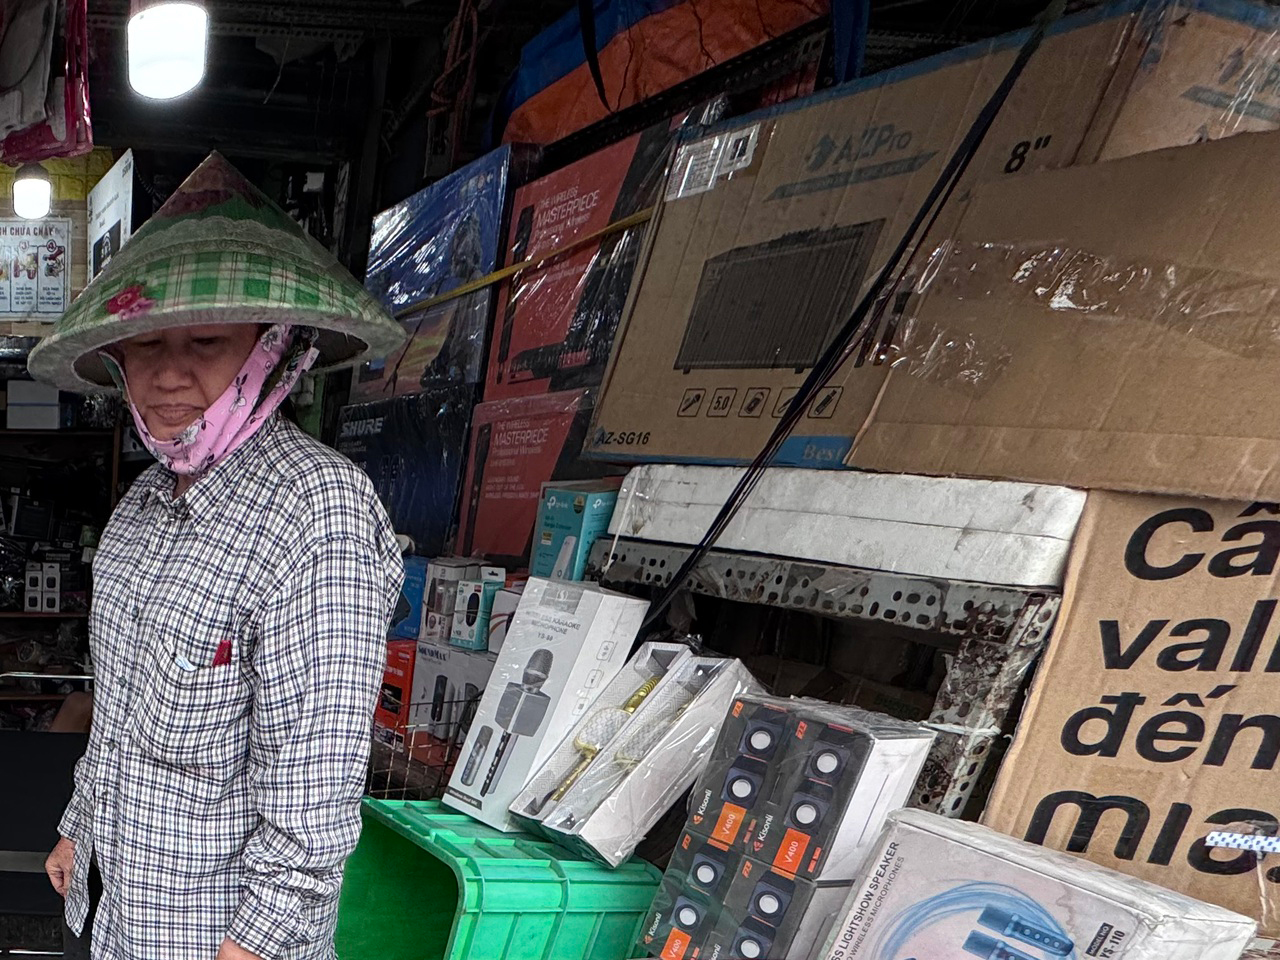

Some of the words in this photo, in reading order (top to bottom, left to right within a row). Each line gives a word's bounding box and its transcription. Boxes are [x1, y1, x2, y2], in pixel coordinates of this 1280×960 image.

[537, 190, 600, 226] MASTERPIECE
[341, 416, 385, 437] SHURE
[494, 428, 549, 446] MASTERPIECE
[596, 430, 651, 446] AZ-SG16
[697, 789, 712, 816] Kisonli
[723, 813, 735, 835] V400
[758, 814, 773, 842] Kisonli
[786, 840, 799, 864] V400
[840, 893, 873, 951] LIGHTSHOW
[867, 841, 900, 897] SPEAKER
[852, 916, 873, 958] WIRELESS
[869, 856, 905, 917] MICROPHONES
[650, 913, 662, 937] Kisonli
[669, 938, 681, 959] V400
[1100, 930, 1126, 959] YS-110
